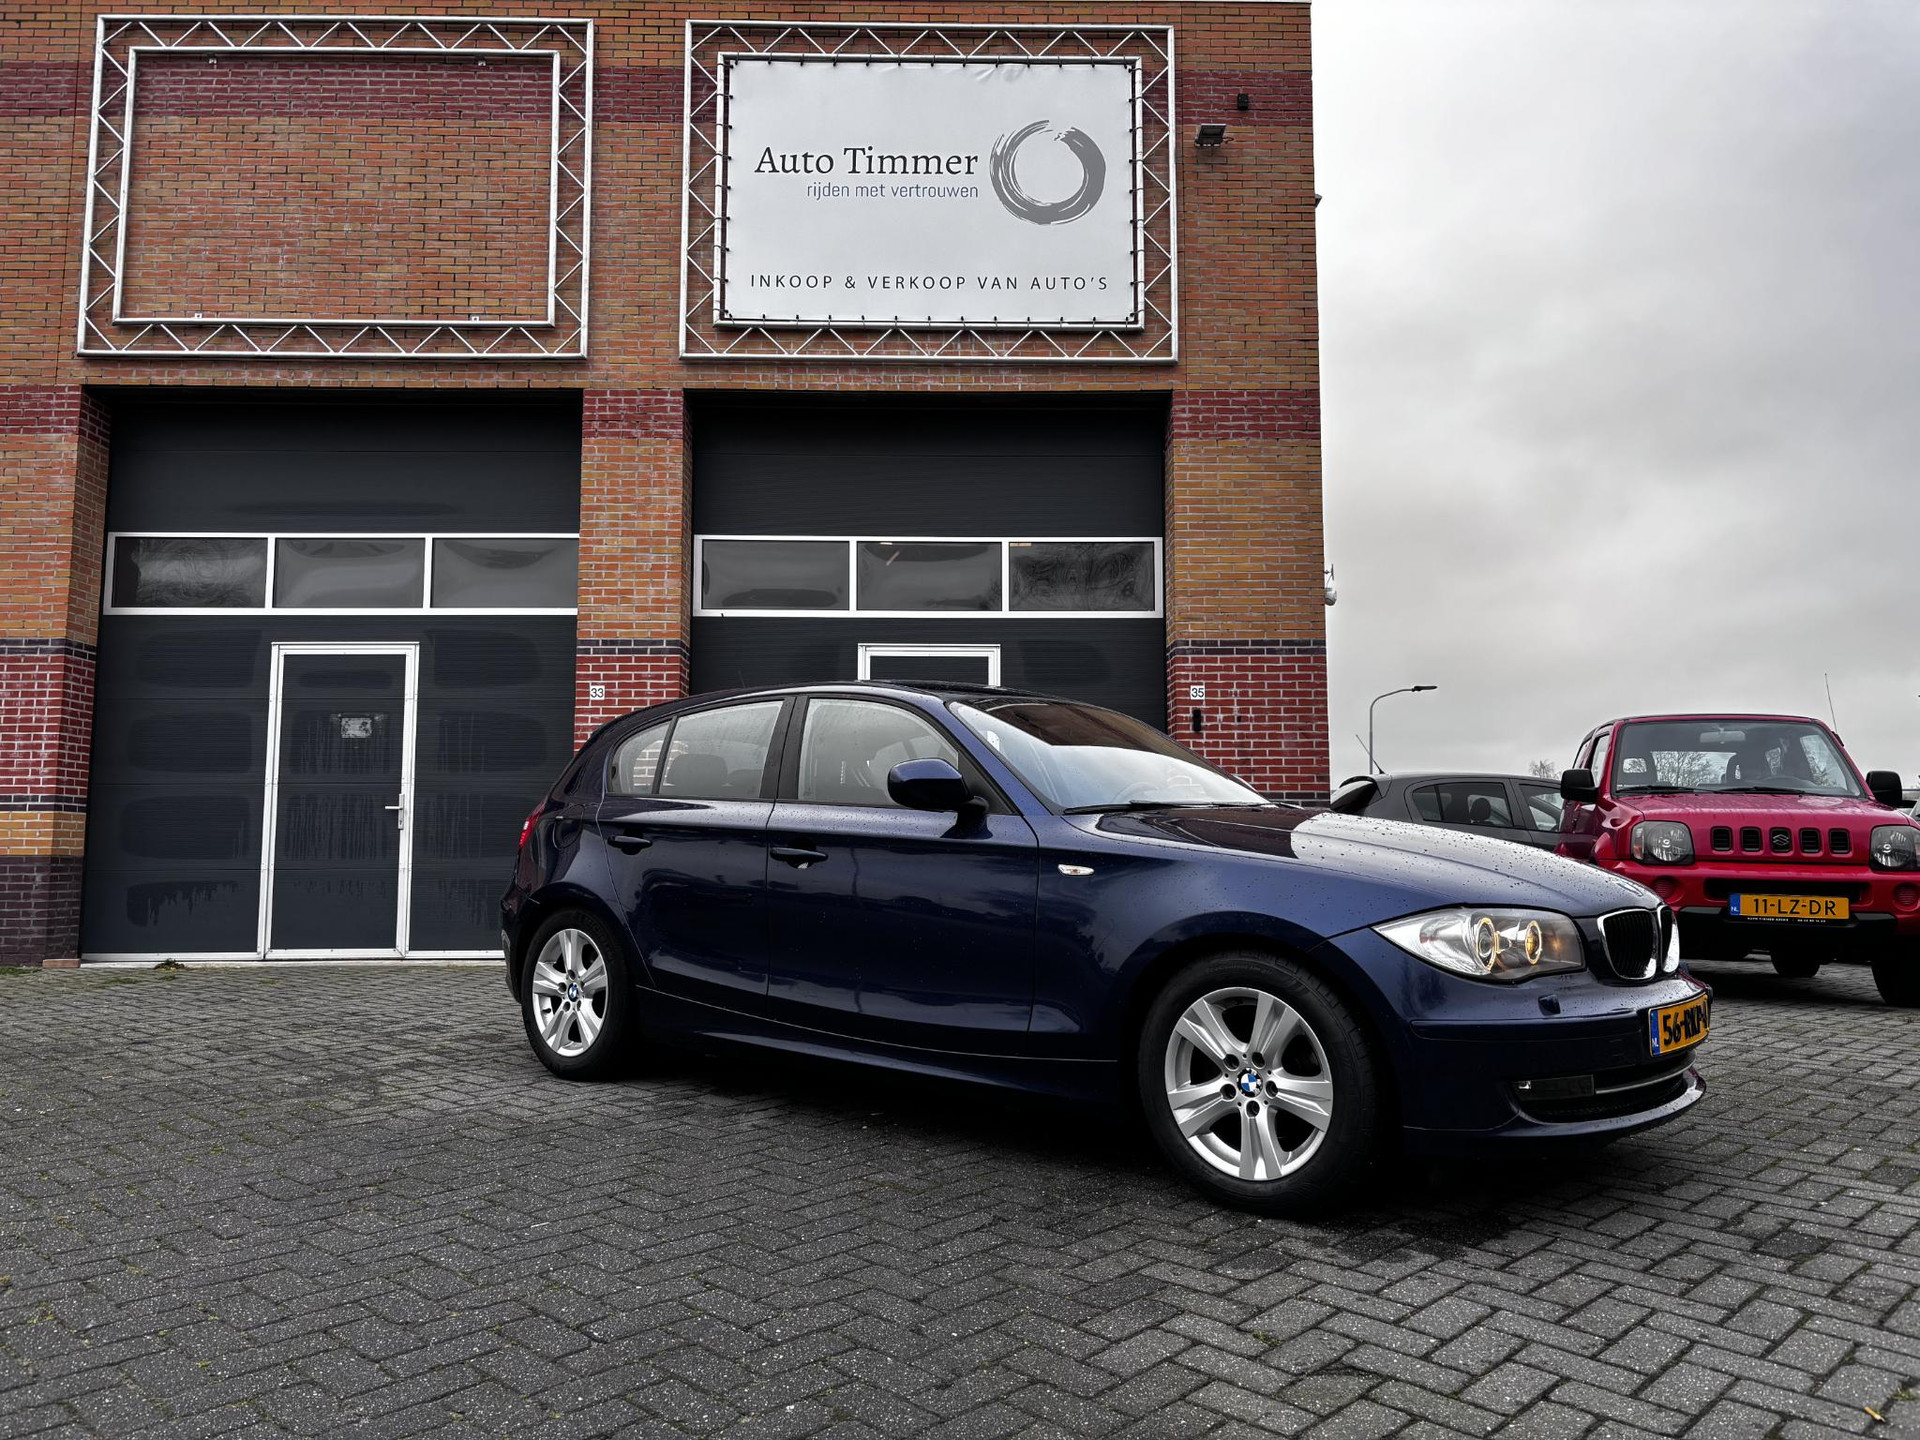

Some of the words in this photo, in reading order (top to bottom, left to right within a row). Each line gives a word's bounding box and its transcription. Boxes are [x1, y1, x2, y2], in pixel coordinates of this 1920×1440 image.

[754, 147, 834, 174] Auto
[843, 146, 978, 175] Timmer
[807, 182, 850, 200] rijden
[855, 183, 886, 198] met
[891, 184, 979, 198] vertrouwen
[751, 274, 832, 289] INKOOP
[845, 275, 856, 289] &
[867, 276, 966, 290] VERKOOP
[977, 276, 1018, 290] VAN
[1030, 276, 1107, 290] AUTO'S
[590, 687, 604, 698] 33
[1191, 687, 1204, 698] 35
[1753, 898, 1836, 916] 11-LZ-DR
